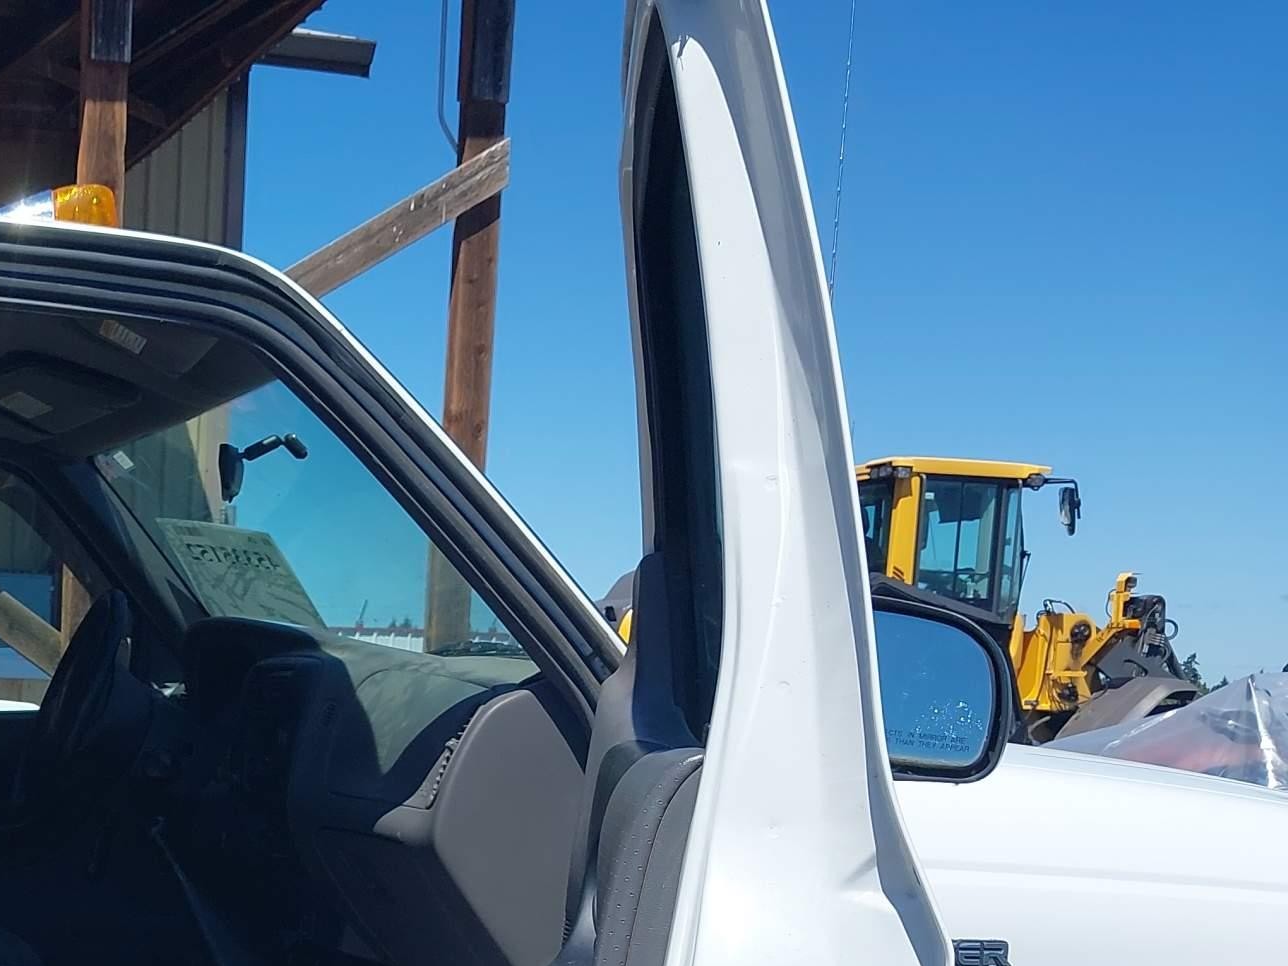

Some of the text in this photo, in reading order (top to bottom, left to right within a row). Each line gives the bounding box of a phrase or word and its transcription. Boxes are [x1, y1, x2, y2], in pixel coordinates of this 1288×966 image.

[895, 738, 914, 747] THAN
[919, 740, 937, 749] THEY
[939, 743, 970, 752] APPEAR
[919, 733, 947, 742] MIRROR
[951, 736, 968, 745] ARE
